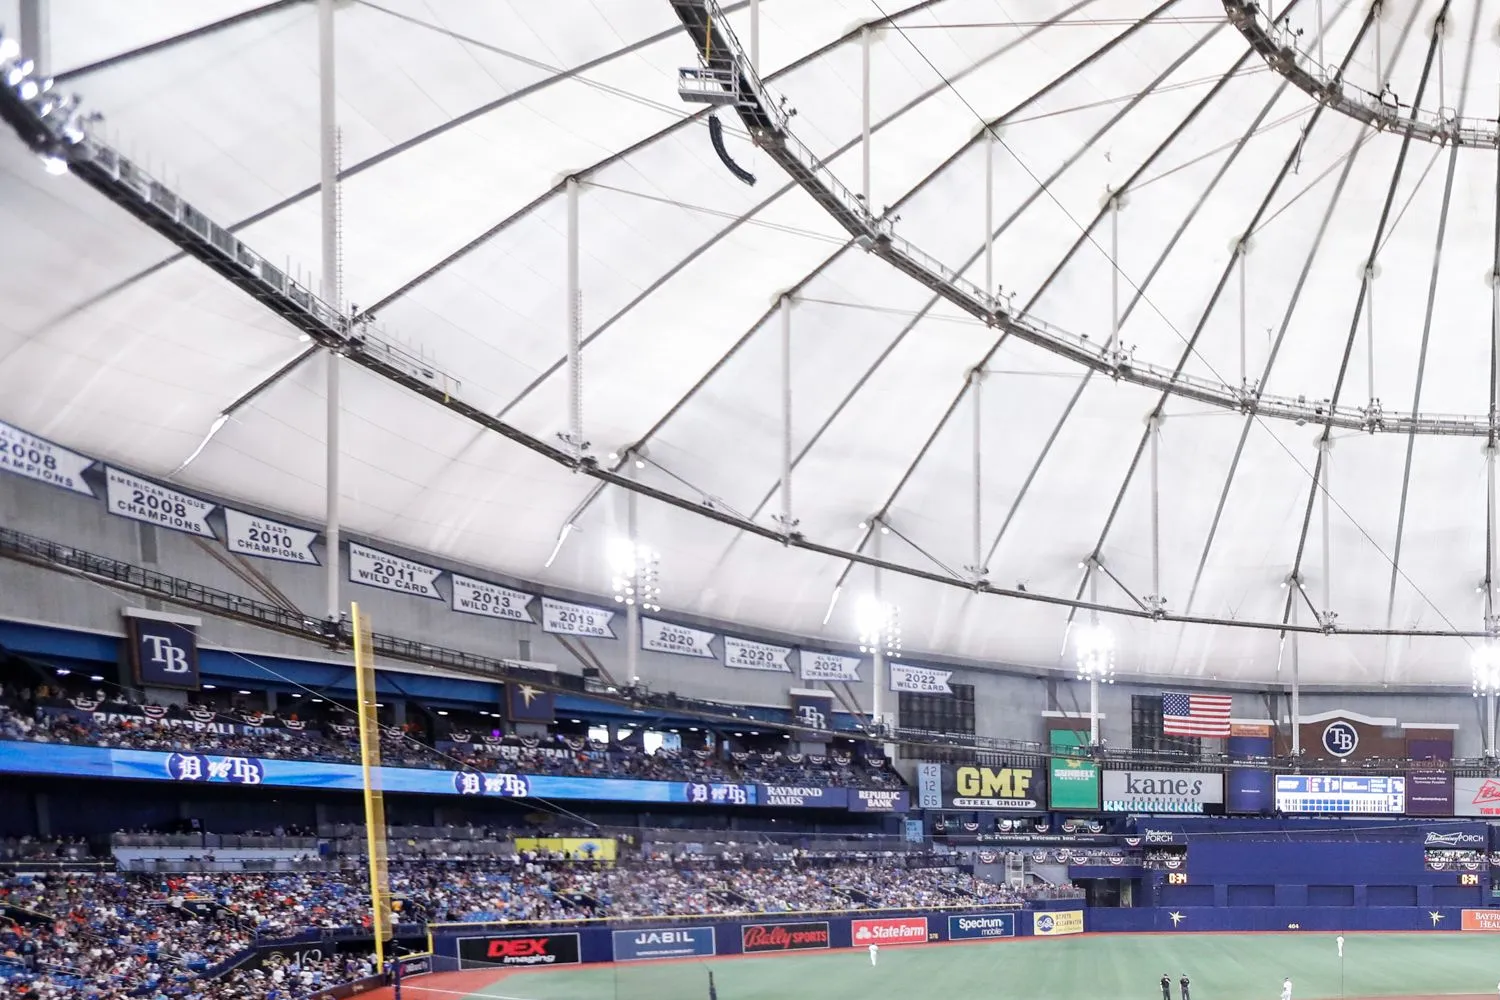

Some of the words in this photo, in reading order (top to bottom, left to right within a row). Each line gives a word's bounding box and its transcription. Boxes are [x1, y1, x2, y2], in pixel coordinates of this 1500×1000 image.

[0, 438, 57, 470] 2008
[0, 455, 73, 487] AMPIONS
[110, 474, 164, 497] AMERICAN
[168, 493, 206, 510] LEAGUE
[132, 490, 187, 518] 2008
[117, 500, 201, 532] CHAMPIONS
[251, 521, 264, 529] AL
[266, 524, 288, 534] EAST
[248, 528, 292, 548] 2010
[237, 539, 305, 560] CHAMPIONS
[352, 549, 398, 566] AMERICAN
[401, 562, 434, 575] LEAGUE
[374, 562, 414, 582] 2011
[359, 569, 389, 584] WILD
[395, 579, 428, 594] CARD
[455, 580, 495, 594] AMERICAN
[497, 589, 526, 600] LEAGUE
[472, 591, 511, 608] 2013
[461, 599, 489, 612] WILD
[493, 606, 522, 618] CARD
[559, 611, 594, 626] 2019
[550, 621, 574, 631] WILD
[578, 625, 604, 635] CARD
[649, 640, 703, 654] CHAMPIONS
[659, 631, 694, 647] 2020
[142, 633, 189, 674] TB
[739, 648, 774, 662] 2020
[729, 657, 783, 670] CHAMPIONS
[814, 660, 843, 672] 2021
[905, 673, 936, 684] 2022
[921, 683, 944, 691] CARD
[1329, 728, 1352, 750] TB
[226, 757, 260, 784] TB
[923, 767, 936, 777] 42
[501, 774, 527, 797] TB
[925, 781, 936, 791] 12
[956, 766, 1032, 798] GMF
[1124, 773, 1203, 796] kanes
[767, 786, 822, 797] RAYMOND
[859, 790, 900, 800] REPUBLIC
[767, 796, 804, 806] JAMES
[867, 799, 892, 808] BANK
[924, 795, 938, 806] 66
[997, 799, 1031, 807] GROUP
[959, 918, 1002, 931] Spectrum
[635, 932, 694, 945] JABIL
[744, 926, 792, 948] Bally
[792, 930, 827, 943] SPORTS
[487, 938, 550, 957] DEX
[504, 953, 555, 964] imaging
